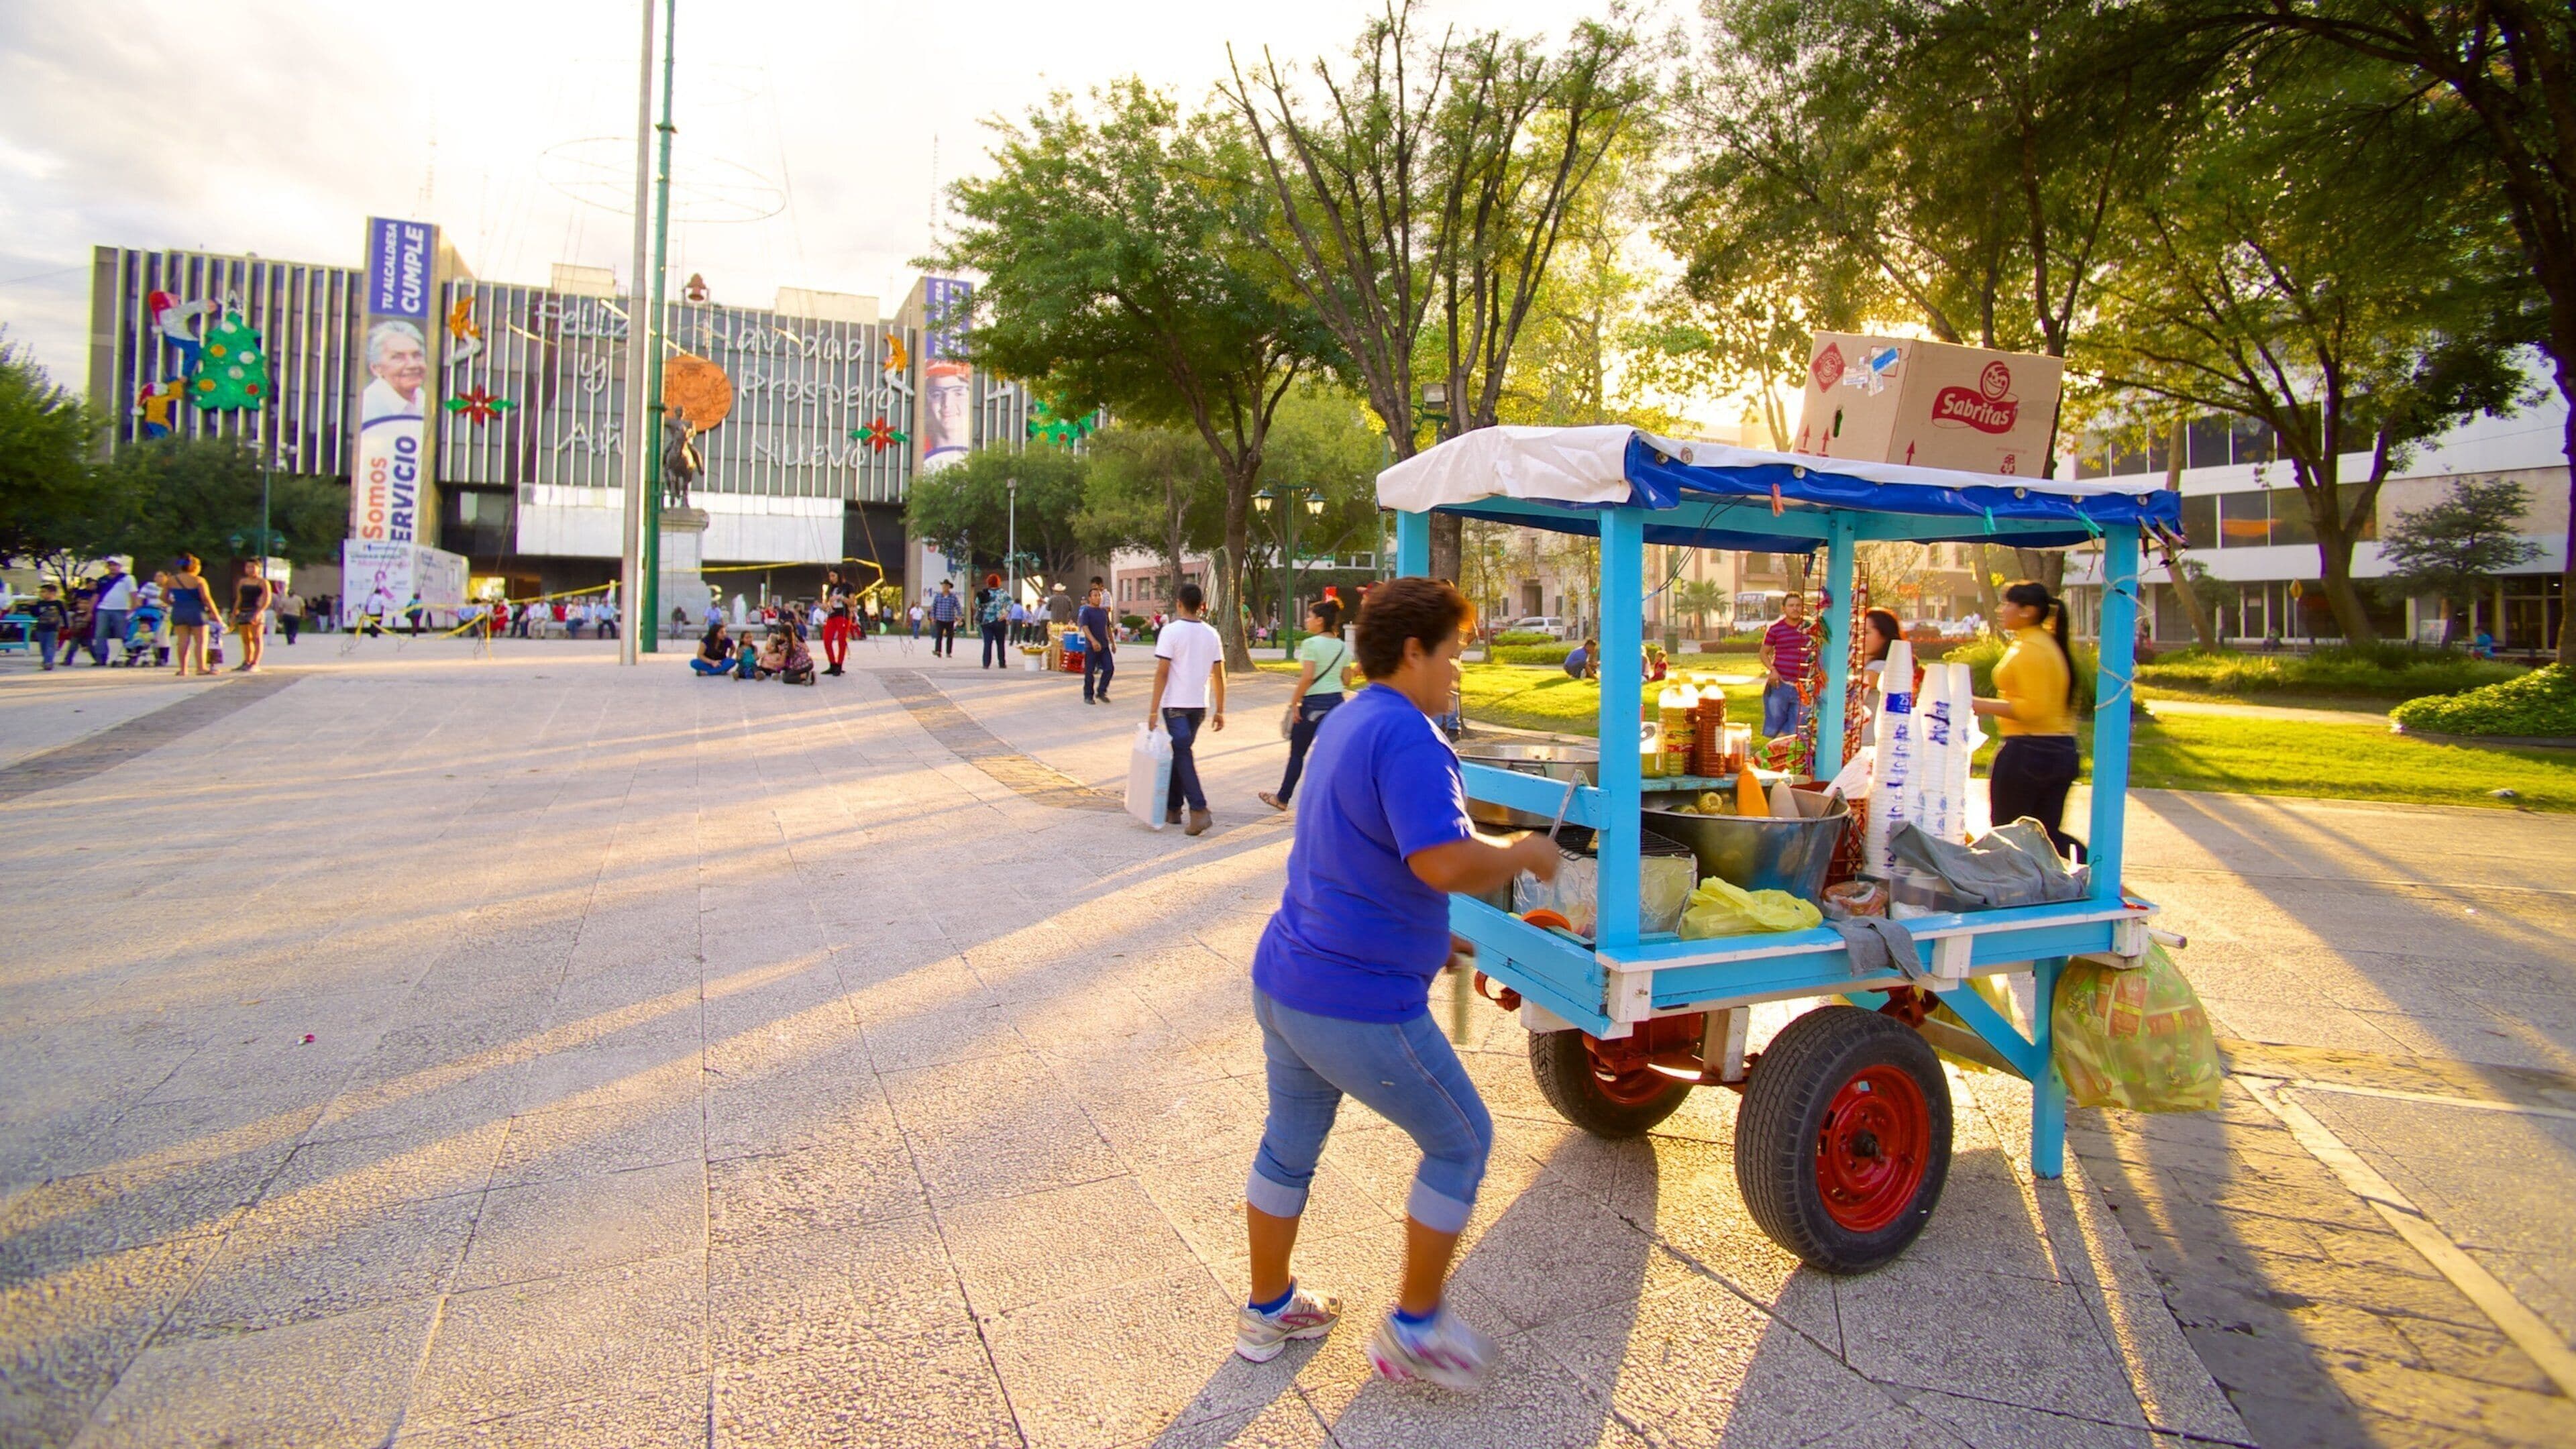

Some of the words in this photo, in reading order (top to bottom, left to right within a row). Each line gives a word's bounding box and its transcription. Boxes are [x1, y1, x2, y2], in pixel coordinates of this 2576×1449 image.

[382, 223, 397, 292] ALCALDESA
[400, 225, 425, 313] CUMPLE
[381, 293, 394, 309] TU
[579, 352, 607, 394] y
[1941, 392, 2010, 426] Sabritas
[557, 421, 624, 456] Añ
[749, 435, 867, 469] Nuevo
[362, 457, 388, 540] Somos
[390, 435, 417, 543] ERVICIO
